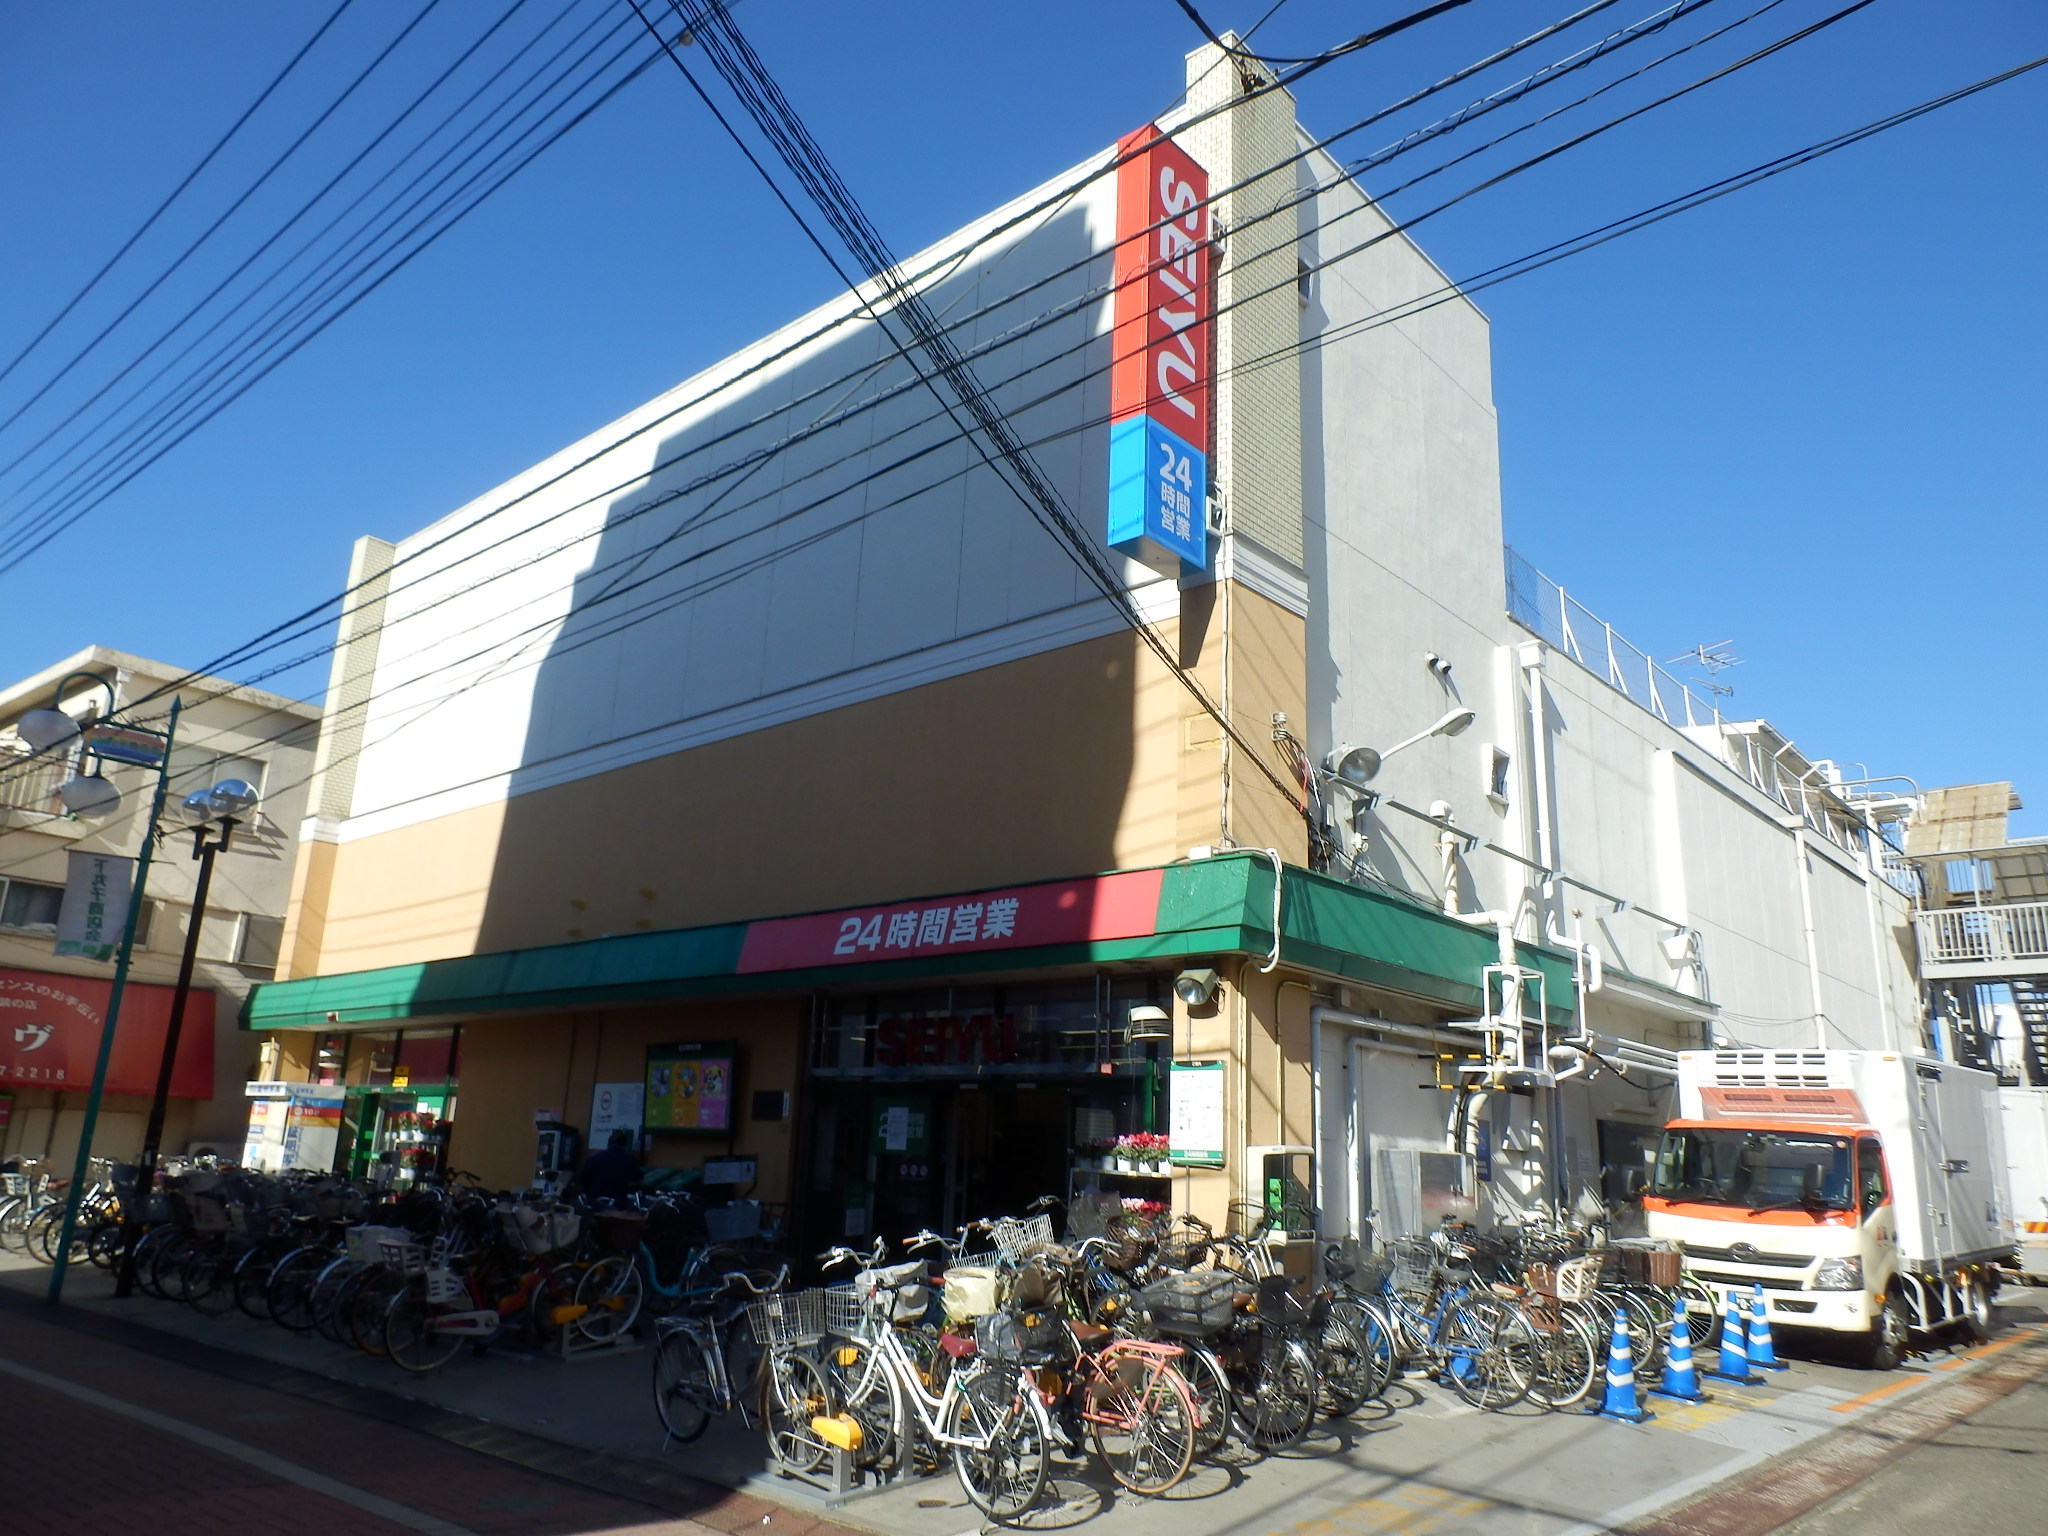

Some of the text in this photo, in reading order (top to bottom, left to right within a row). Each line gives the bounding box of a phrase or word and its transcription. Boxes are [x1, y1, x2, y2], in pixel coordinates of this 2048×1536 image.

[1157, 165, 1198, 420] SEIYU
[1160, 442, 1192, 493] 24
[1161, 481, 1190, 519] 時間
[1161, 505, 1190, 542] 営業
[834, 897, 1019, 955] 24時間営業
[876, 1013, 1017, 1066] SEIYU
